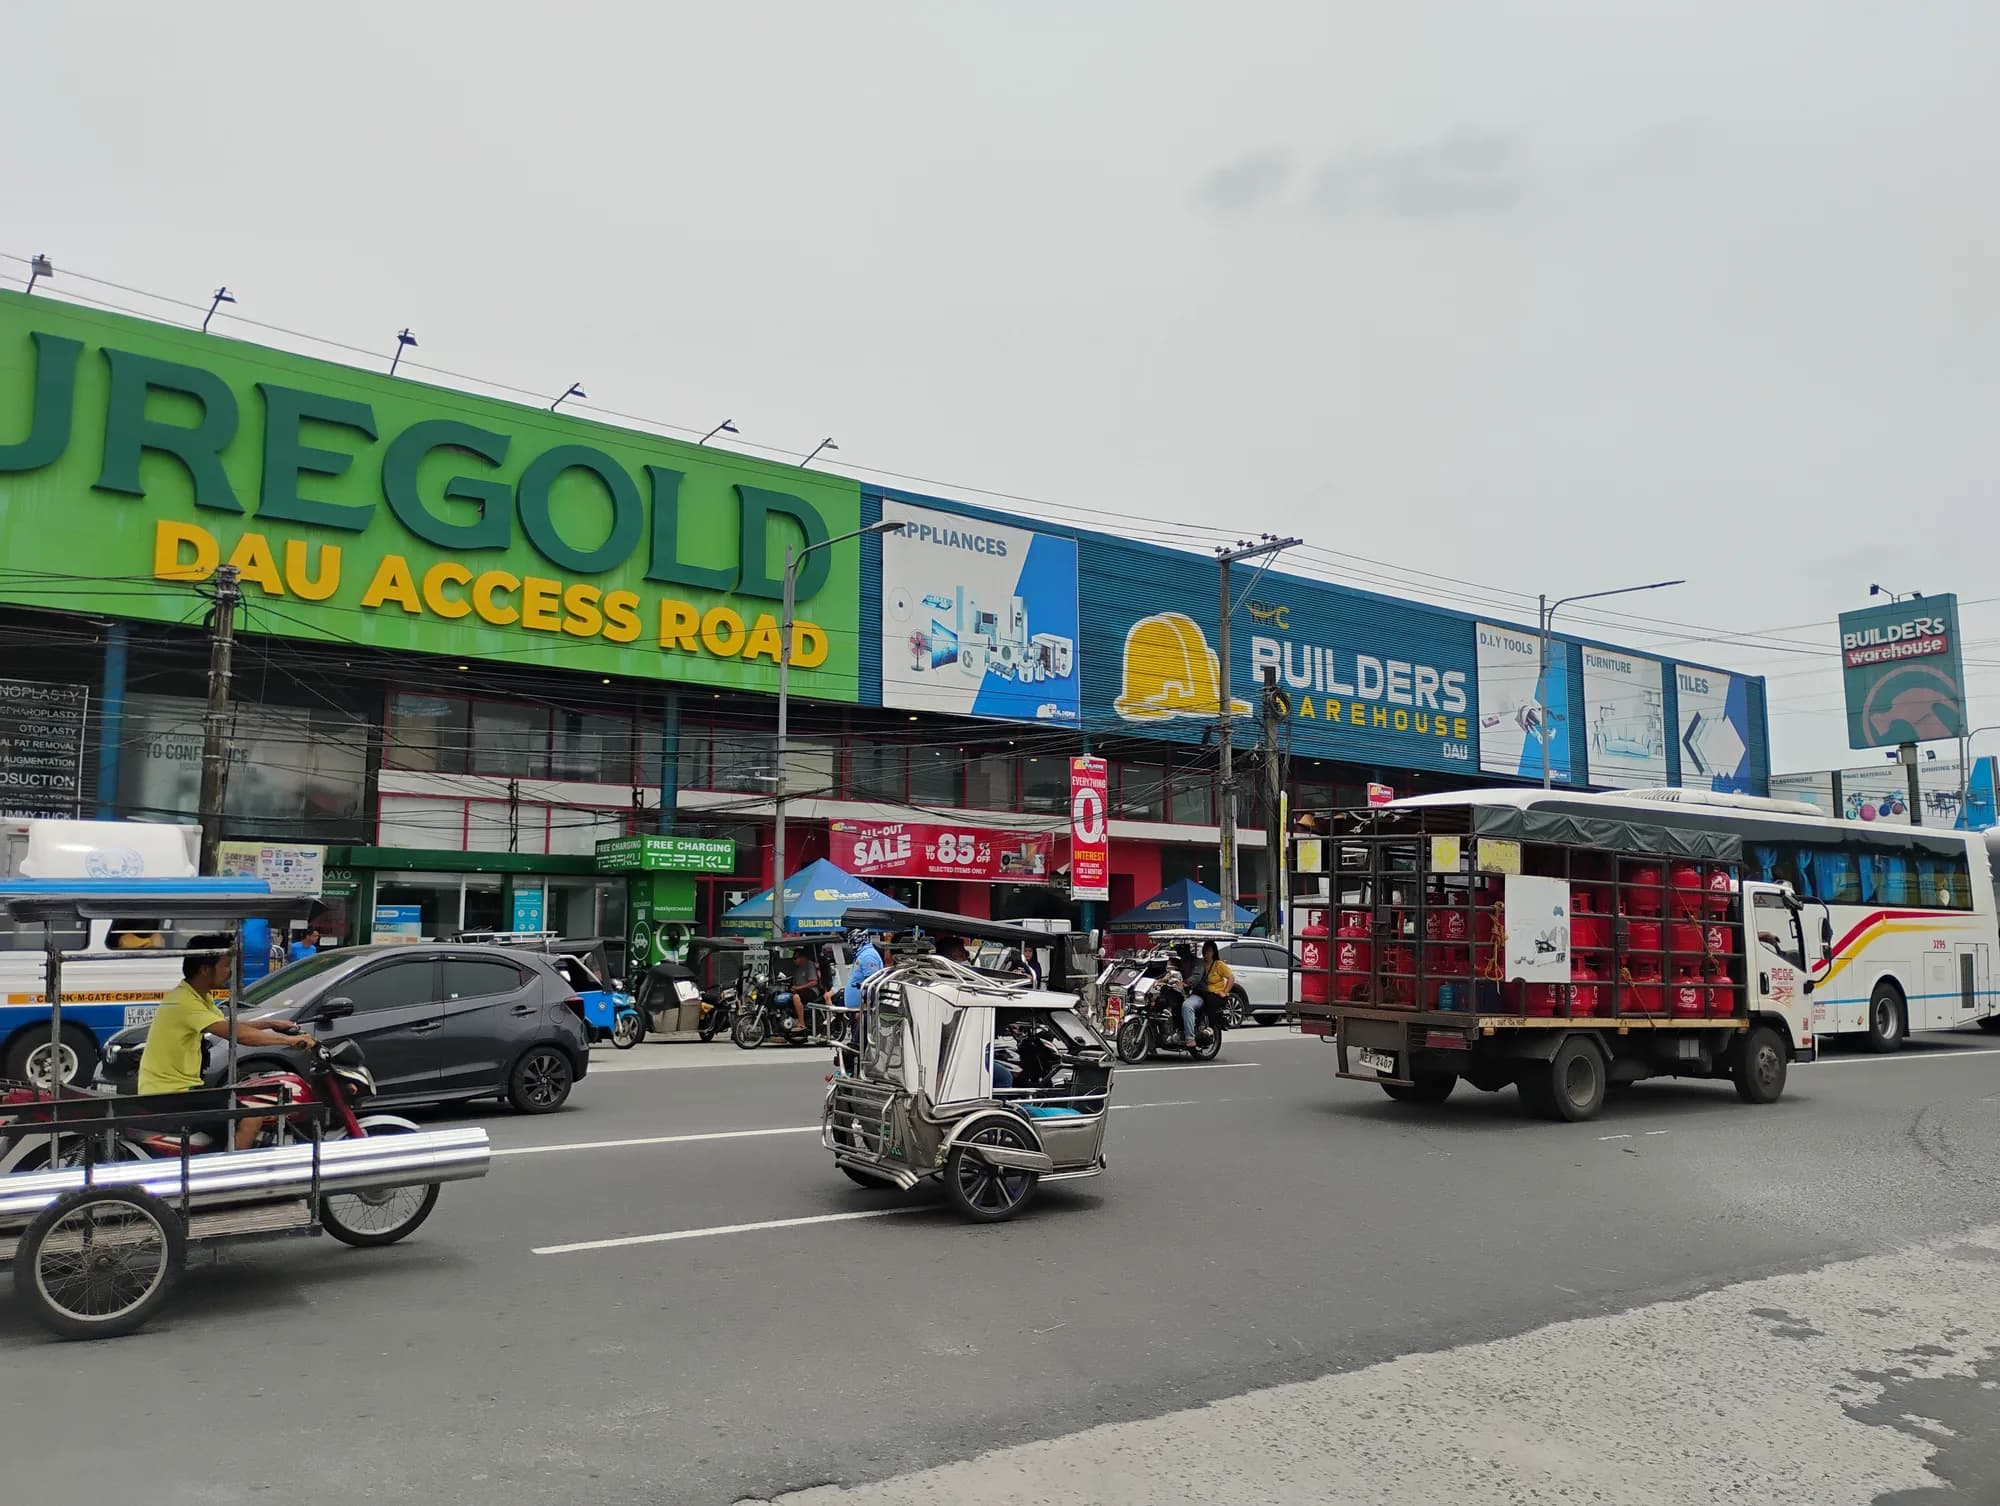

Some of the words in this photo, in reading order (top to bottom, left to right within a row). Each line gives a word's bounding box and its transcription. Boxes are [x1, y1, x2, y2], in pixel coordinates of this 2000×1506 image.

[893, 521, 1008, 558] APPLIANCES
[154, 519, 342, 600] DAU
[360, 554, 642, 643] ACCESS
[660, 599, 830, 669] ROAD
[1843, 617, 1946, 651] BUILDERS
[1503, 637, 1534, 656] TOOLS
[1848, 638, 1944, 666] warehouse
[1585, 654, 1632, 675] FURNITURE
[1251, 636, 1467, 713] BUILDERS
[1678, 673, 1709, 696] TILES
[19, 724, 76, 737] OTOPLASTY
[14, 739, 30, 748] FAT
[32, 740, 76, 751] REMOVAL
[145, 742, 162, 759] TO
[1443, 741, 1469, 761] DAU
[3, 755, 76, 767] AUGMENTATION
[861, 824, 904, 840] ALL-OUT
[596, 844, 610, 854] FREE
[611, 839, 641, 852] CHARGING
[647, 840, 674, 850] FREE
[677, 842, 732, 853] CHARGING
[853, 834, 912, 866] SALE
[925, 845, 935, 853] UP
[937, 833, 975, 865] 85
[925, 852, 935, 860] TO
[976, 855, 991, 864] OFF
[1074, 850, 1105, 862] INTEREST
[971, 867, 987, 875] ONLY
[798, 919, 832, 928] BUILDING
